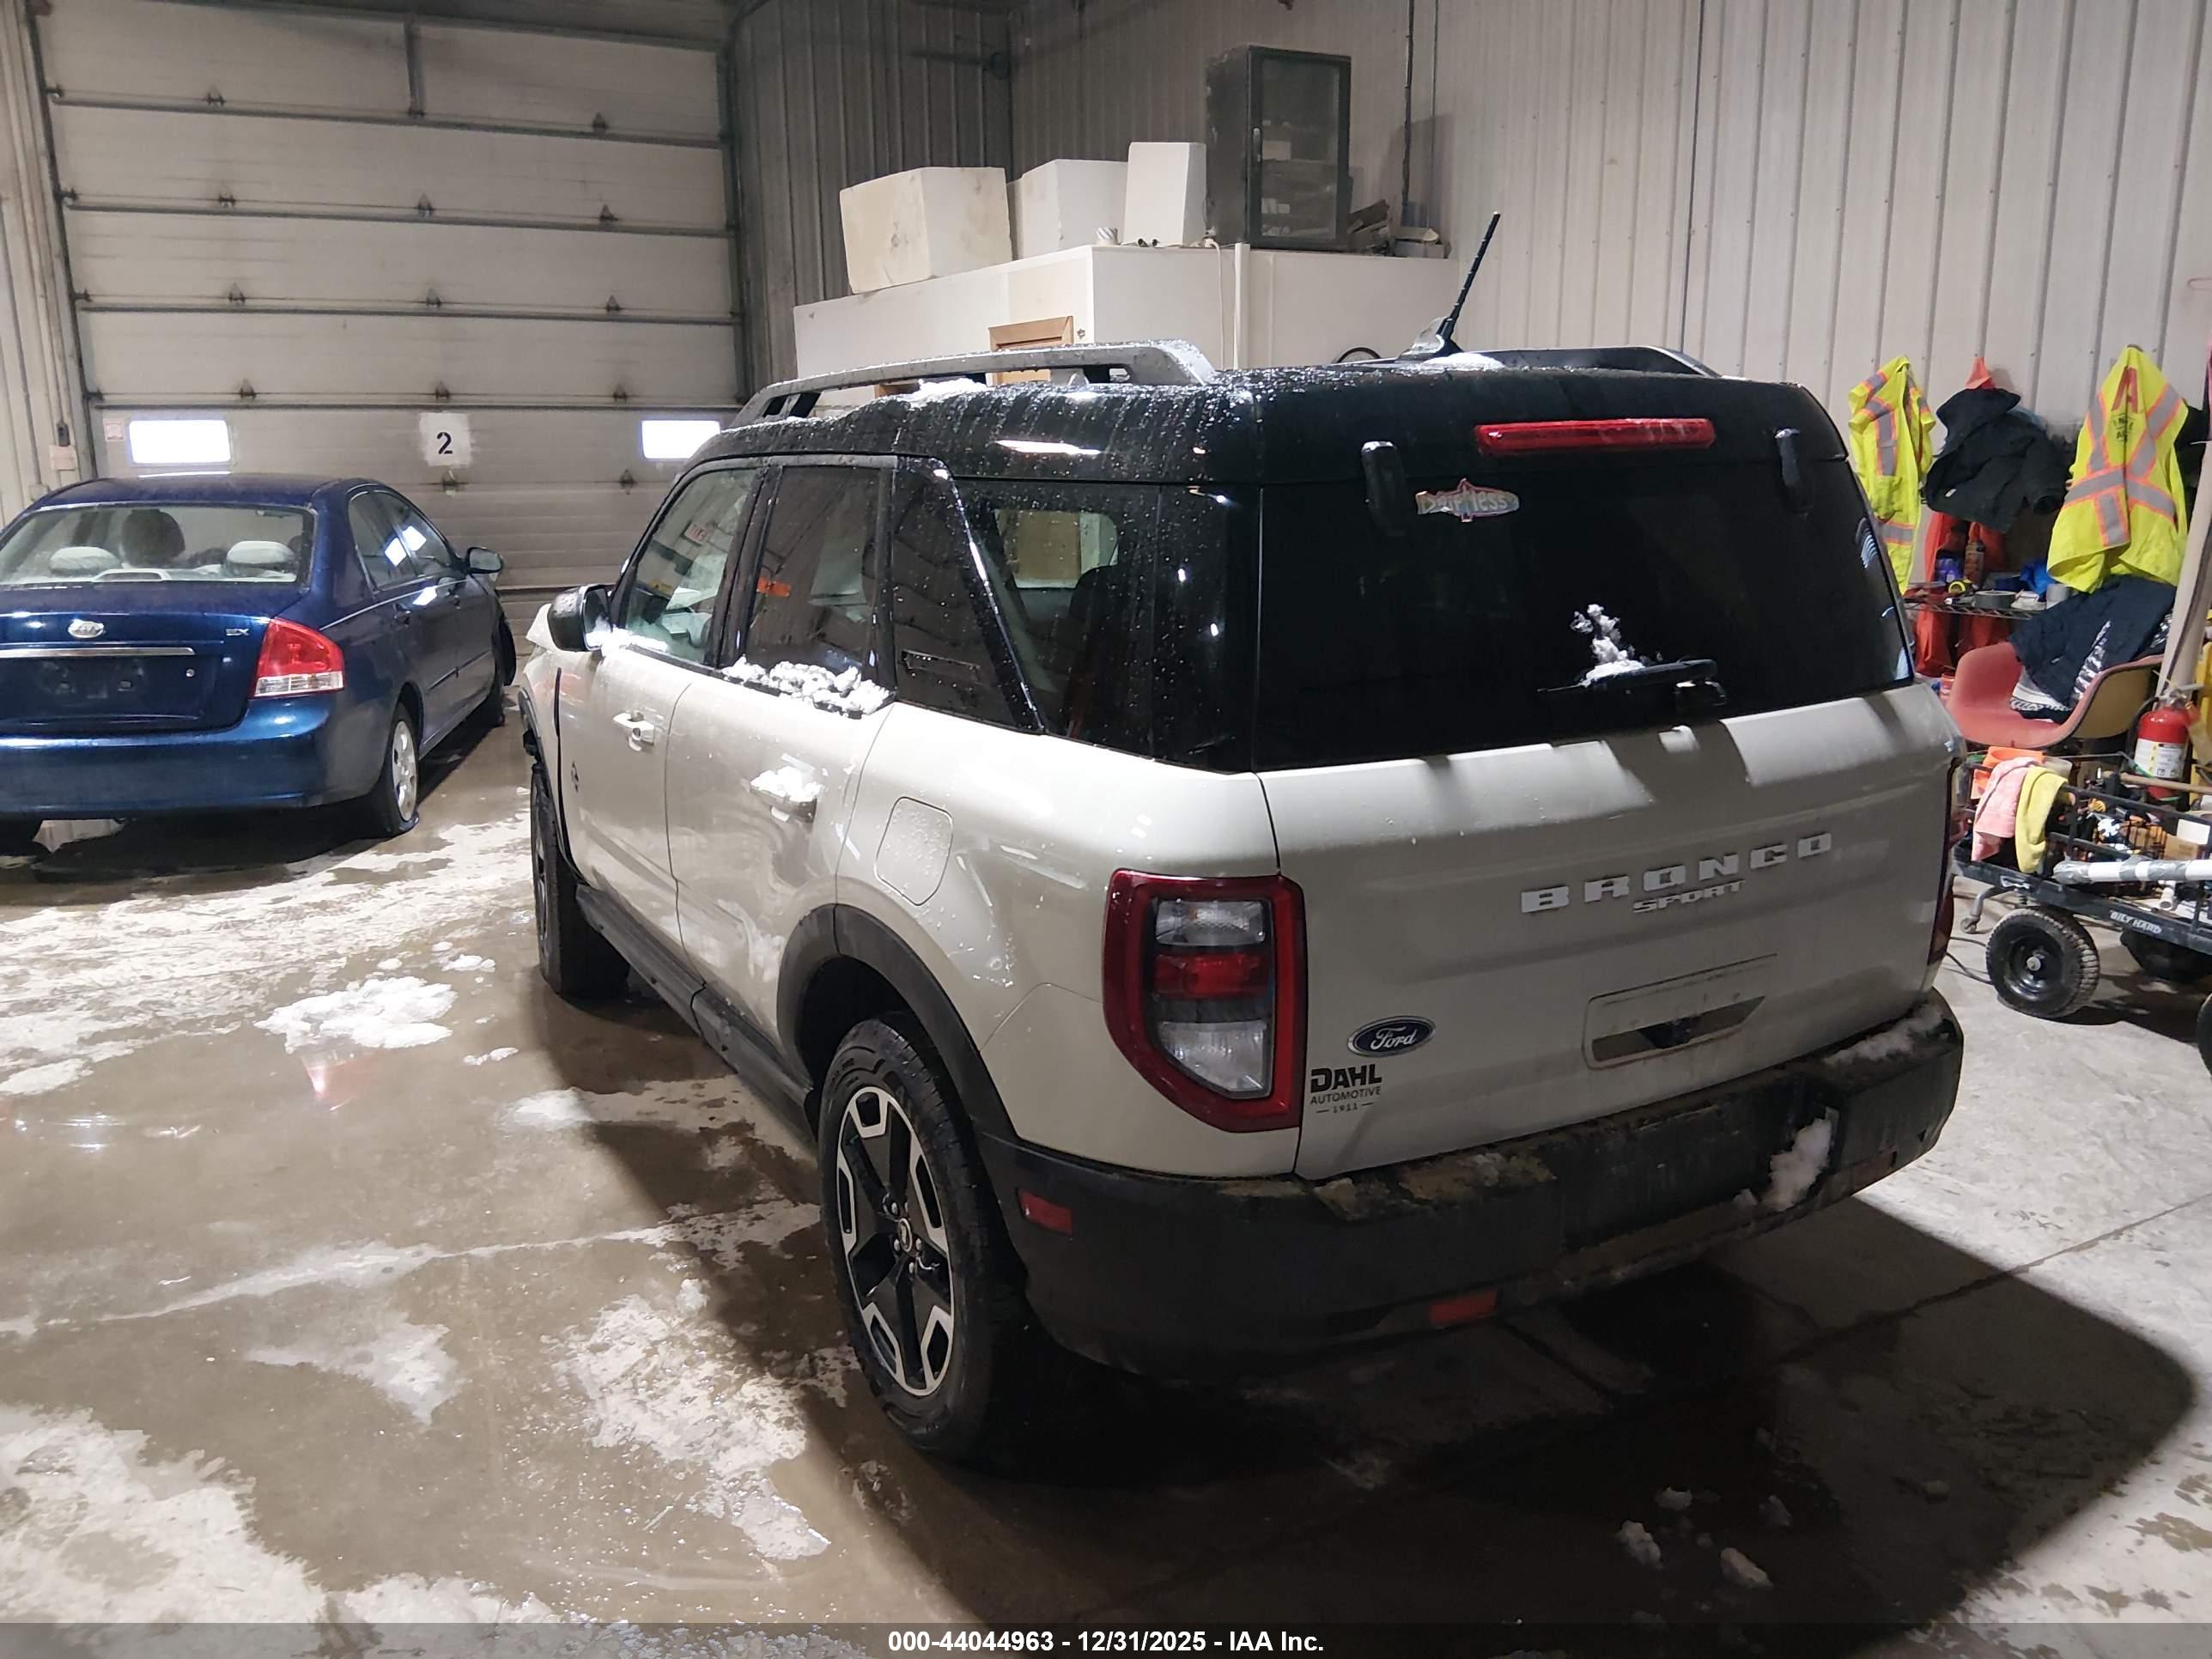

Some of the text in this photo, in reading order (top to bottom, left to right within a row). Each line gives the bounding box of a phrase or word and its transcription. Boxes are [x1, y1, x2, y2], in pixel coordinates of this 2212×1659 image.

[436, 431, 453, 455] 2
[226, 628, 250, 636] EX
[1521, 832, 1832, 914] BRONCO
[1632, 879, 1746, 914] SPORT
[1370, 1026, 1418, 1050] Ford
[1310, 1064, 1383, 1094] DAHL
[1310, 1085, 1382, 1106] AUTOMOTIVE
